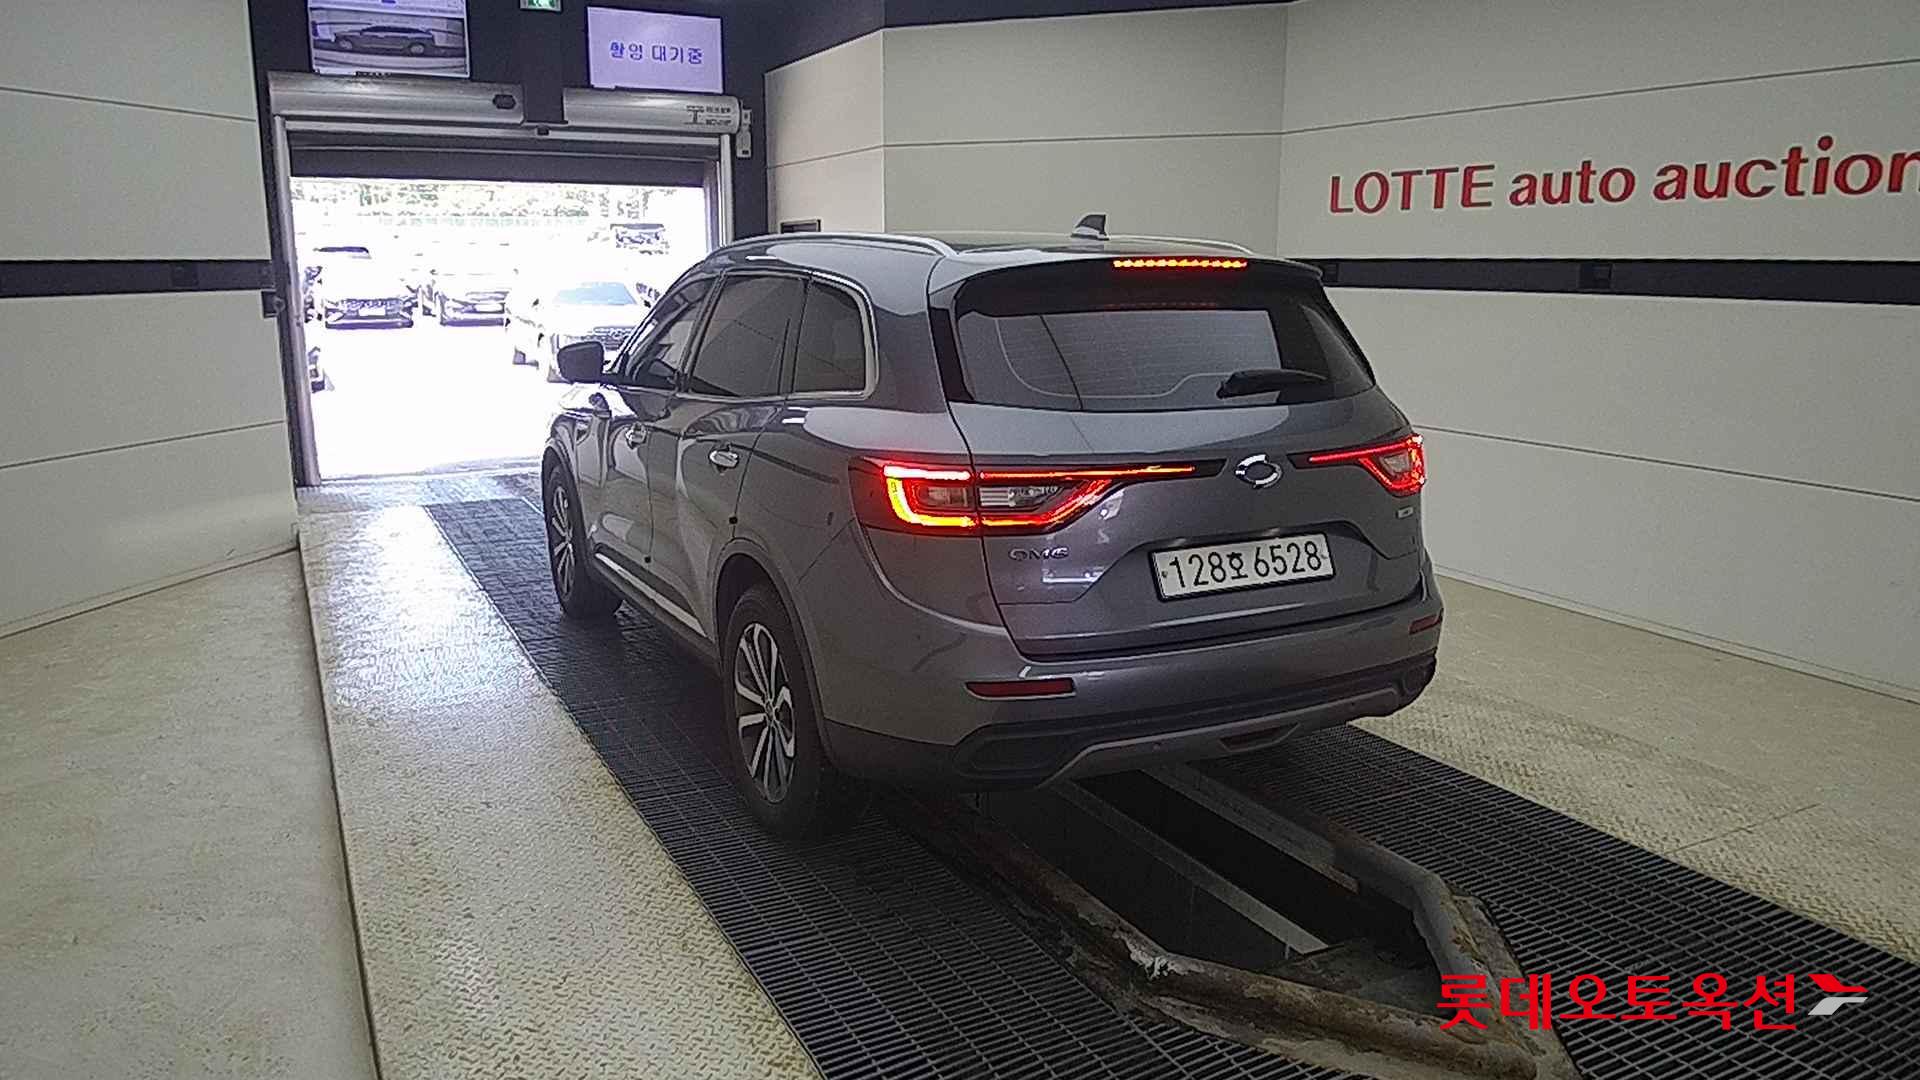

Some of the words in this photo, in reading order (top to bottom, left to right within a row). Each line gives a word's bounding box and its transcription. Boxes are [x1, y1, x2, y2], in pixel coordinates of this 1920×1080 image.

[651, 45, 703, 65] 대기중
[1330, 164, 1496, 214] LOTTE
[1509, 160, 1637, 206] auto
[1169, 551, 1249, 588] 128호
[1254, 541, 1322, 577] 6528
